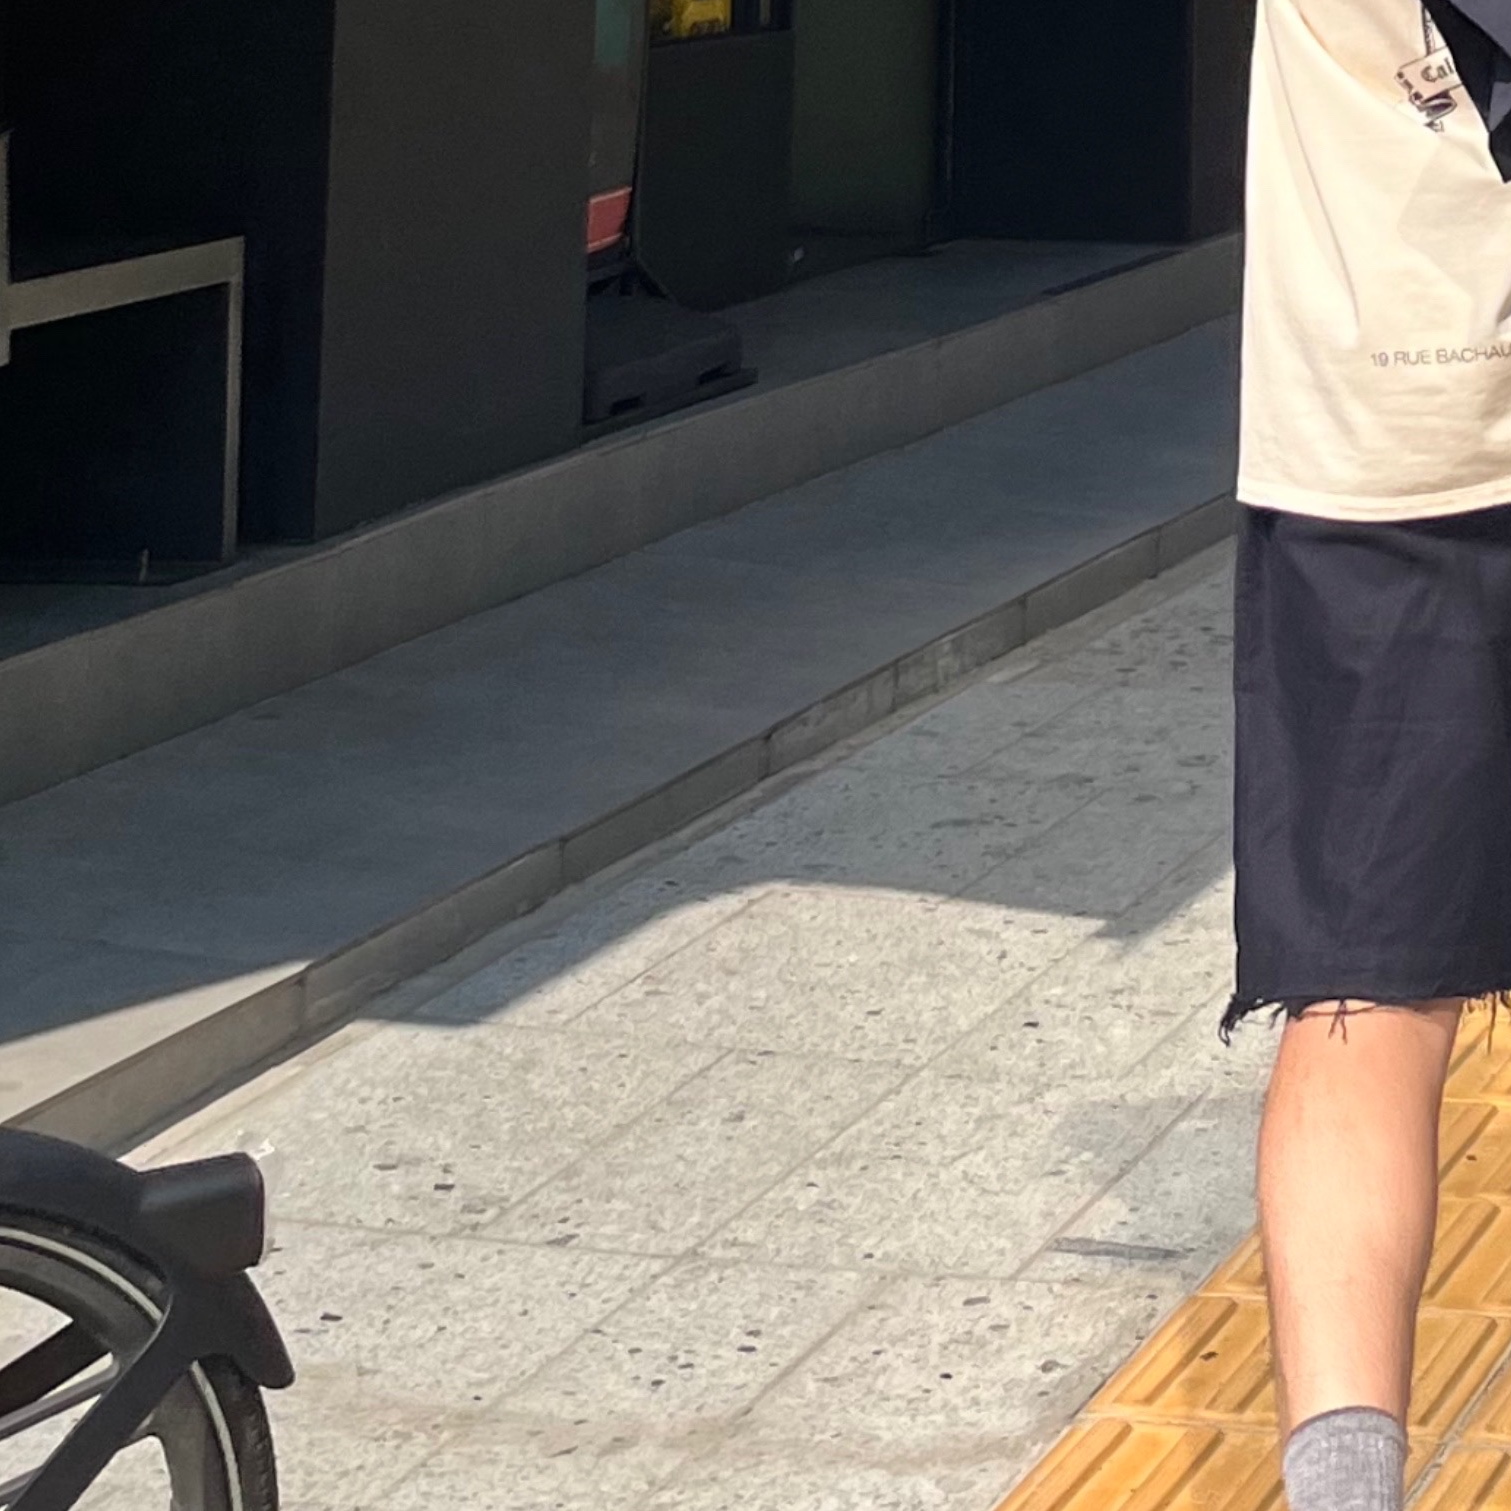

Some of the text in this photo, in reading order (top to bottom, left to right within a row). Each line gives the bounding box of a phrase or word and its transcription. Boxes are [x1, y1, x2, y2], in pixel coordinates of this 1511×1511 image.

[1420, 56, 1454, 83] Cal
[1370, 352, 1389, 367] 19
[1393, 348, 1433, 367] RUE
